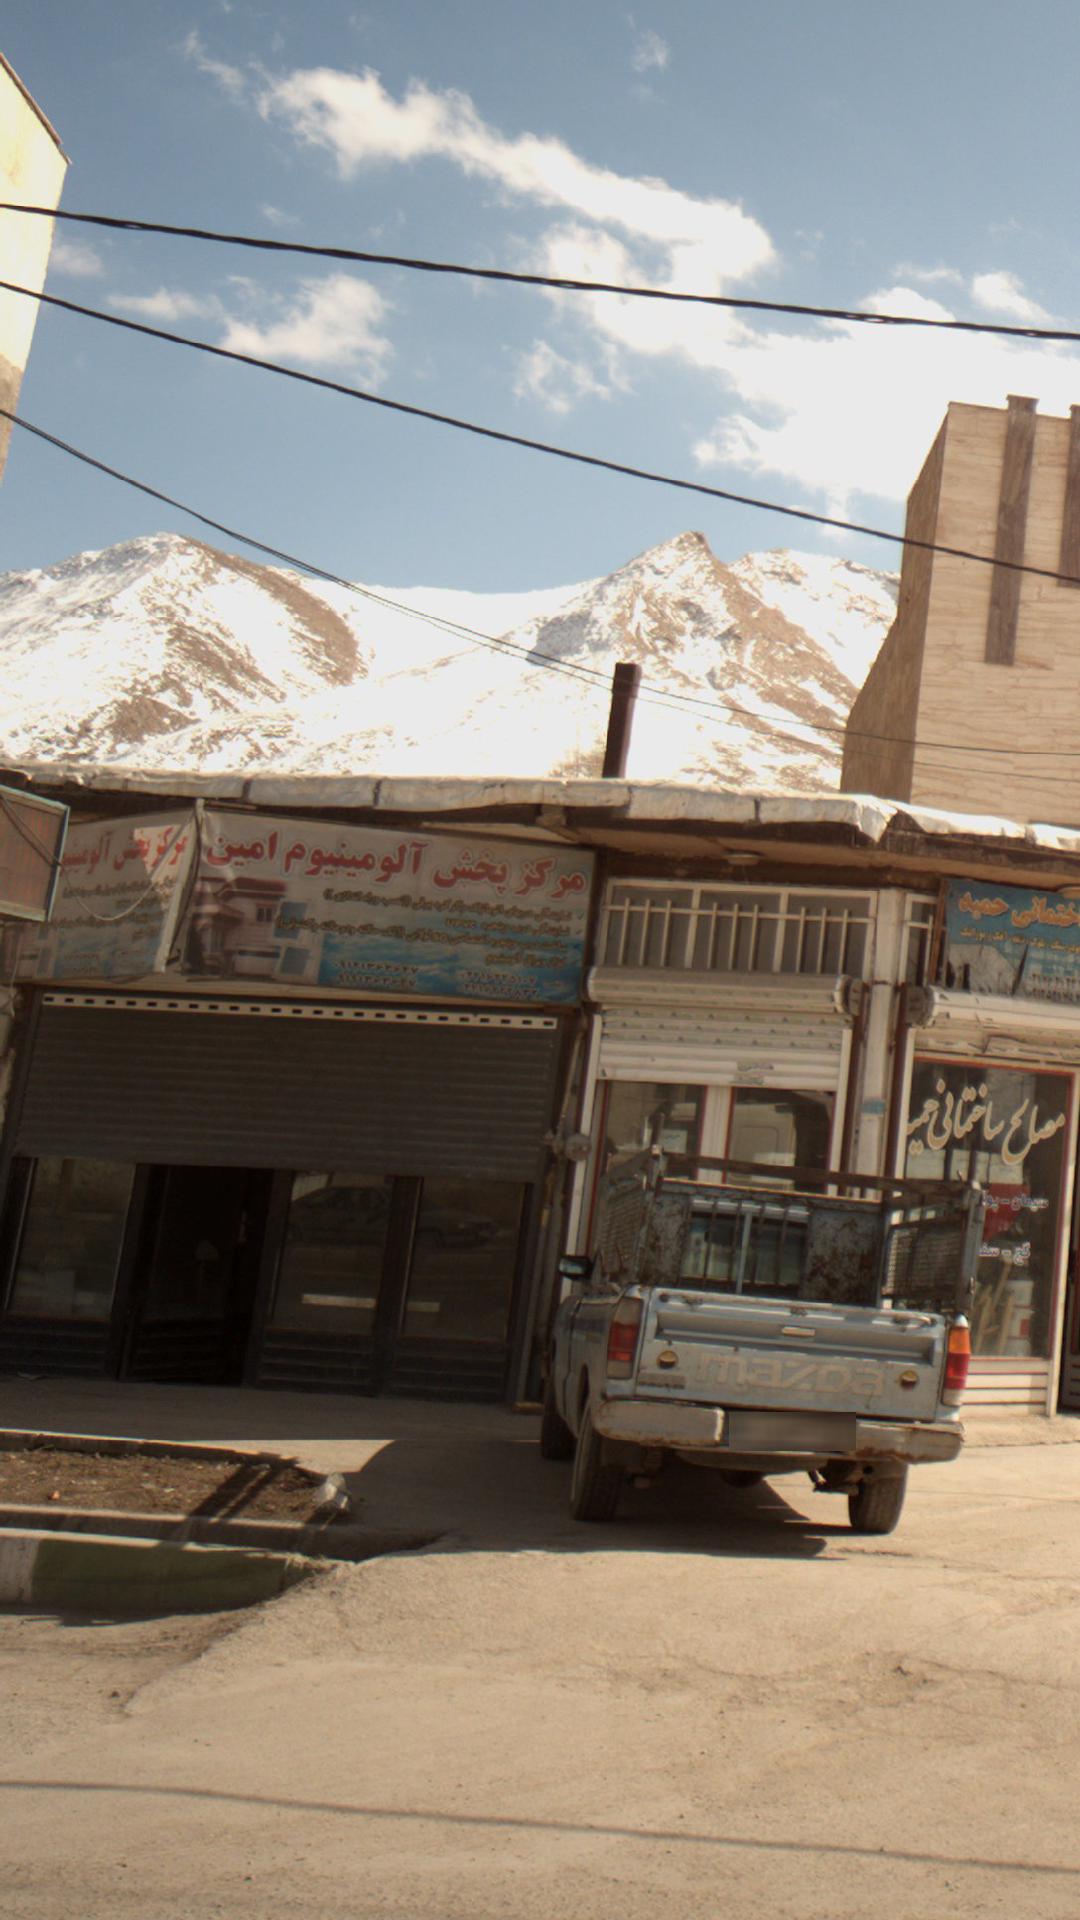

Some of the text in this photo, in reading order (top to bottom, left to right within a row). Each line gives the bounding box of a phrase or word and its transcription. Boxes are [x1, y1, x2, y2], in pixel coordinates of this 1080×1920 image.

[206, 832, 588, 899] مرکز پخش آلومینیوم امین
[906, 1078, 1066, 1166] مصالح ساختمانی حمی
[695, 1352, 886, 1397] mazda
